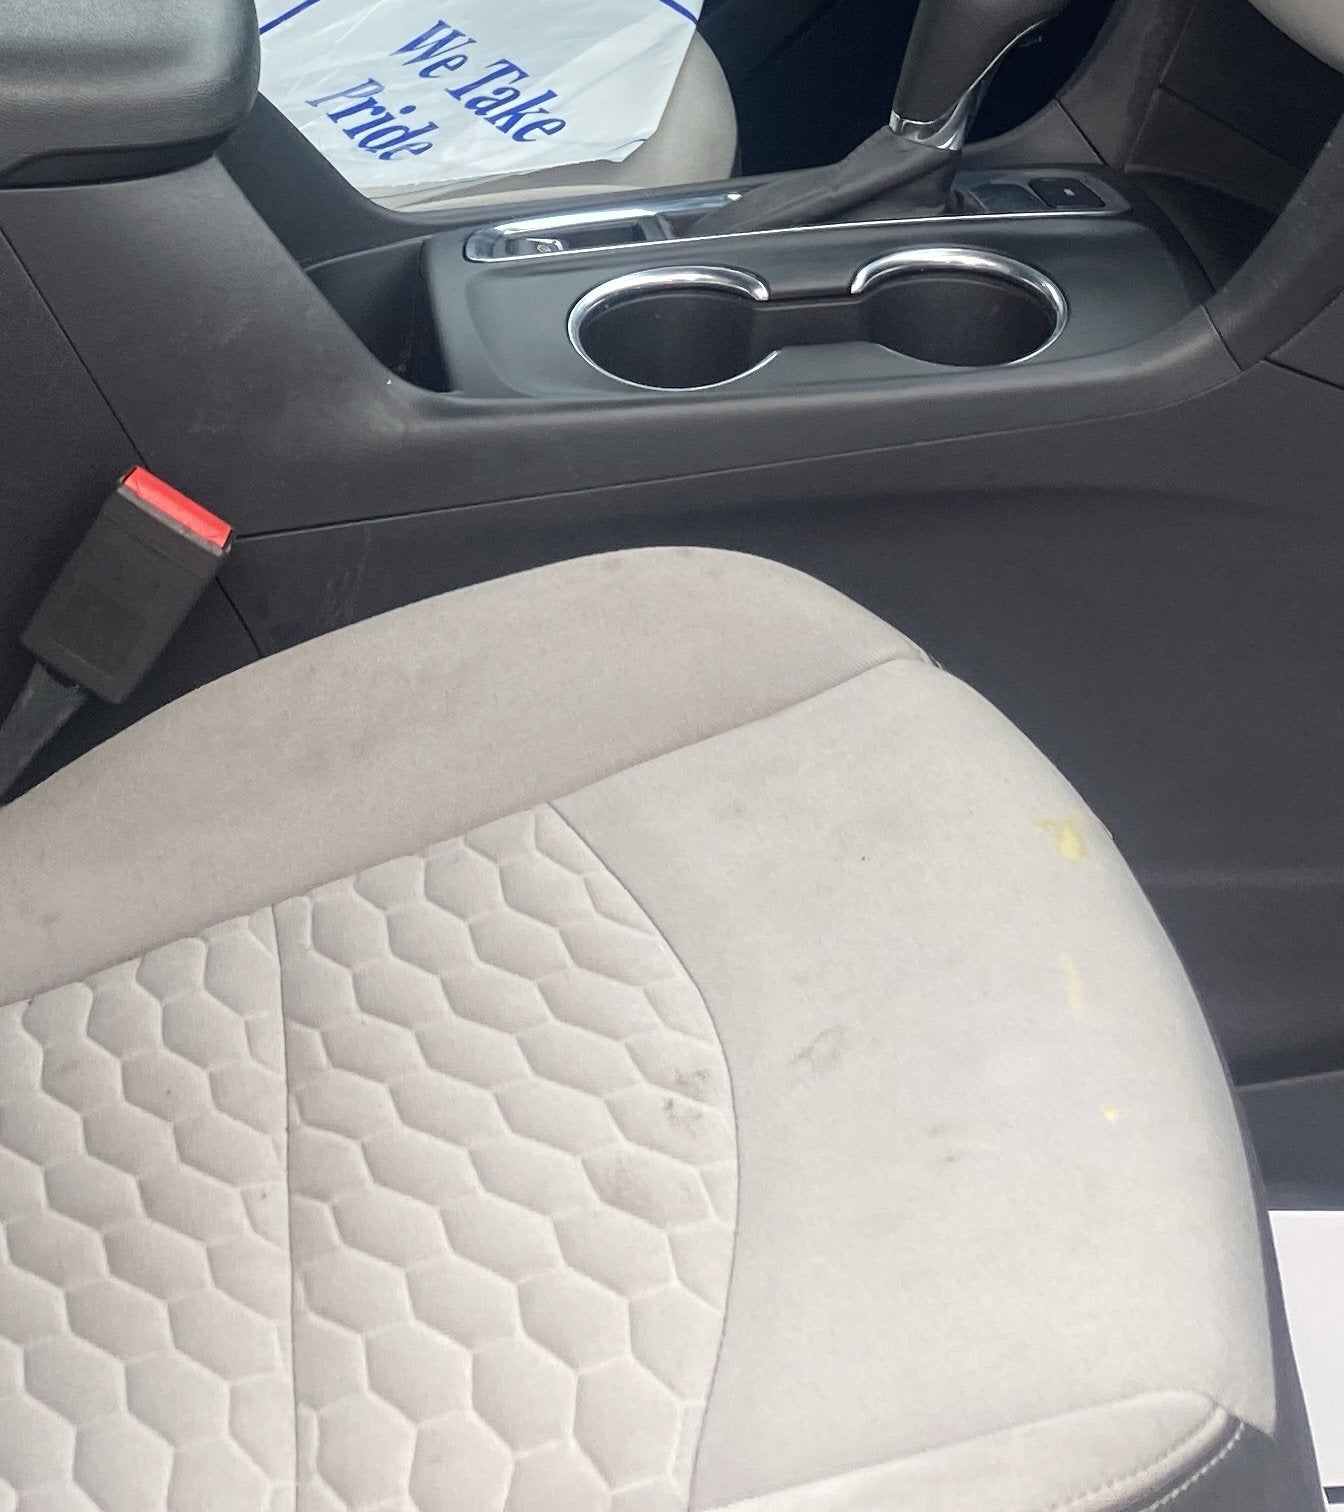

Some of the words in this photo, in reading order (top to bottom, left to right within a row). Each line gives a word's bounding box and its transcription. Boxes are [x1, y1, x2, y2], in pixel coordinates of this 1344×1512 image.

[305, 78, 440, 161] Pride
[388, 20, 478, 78] We
[444, 58, 567, 143] Take
